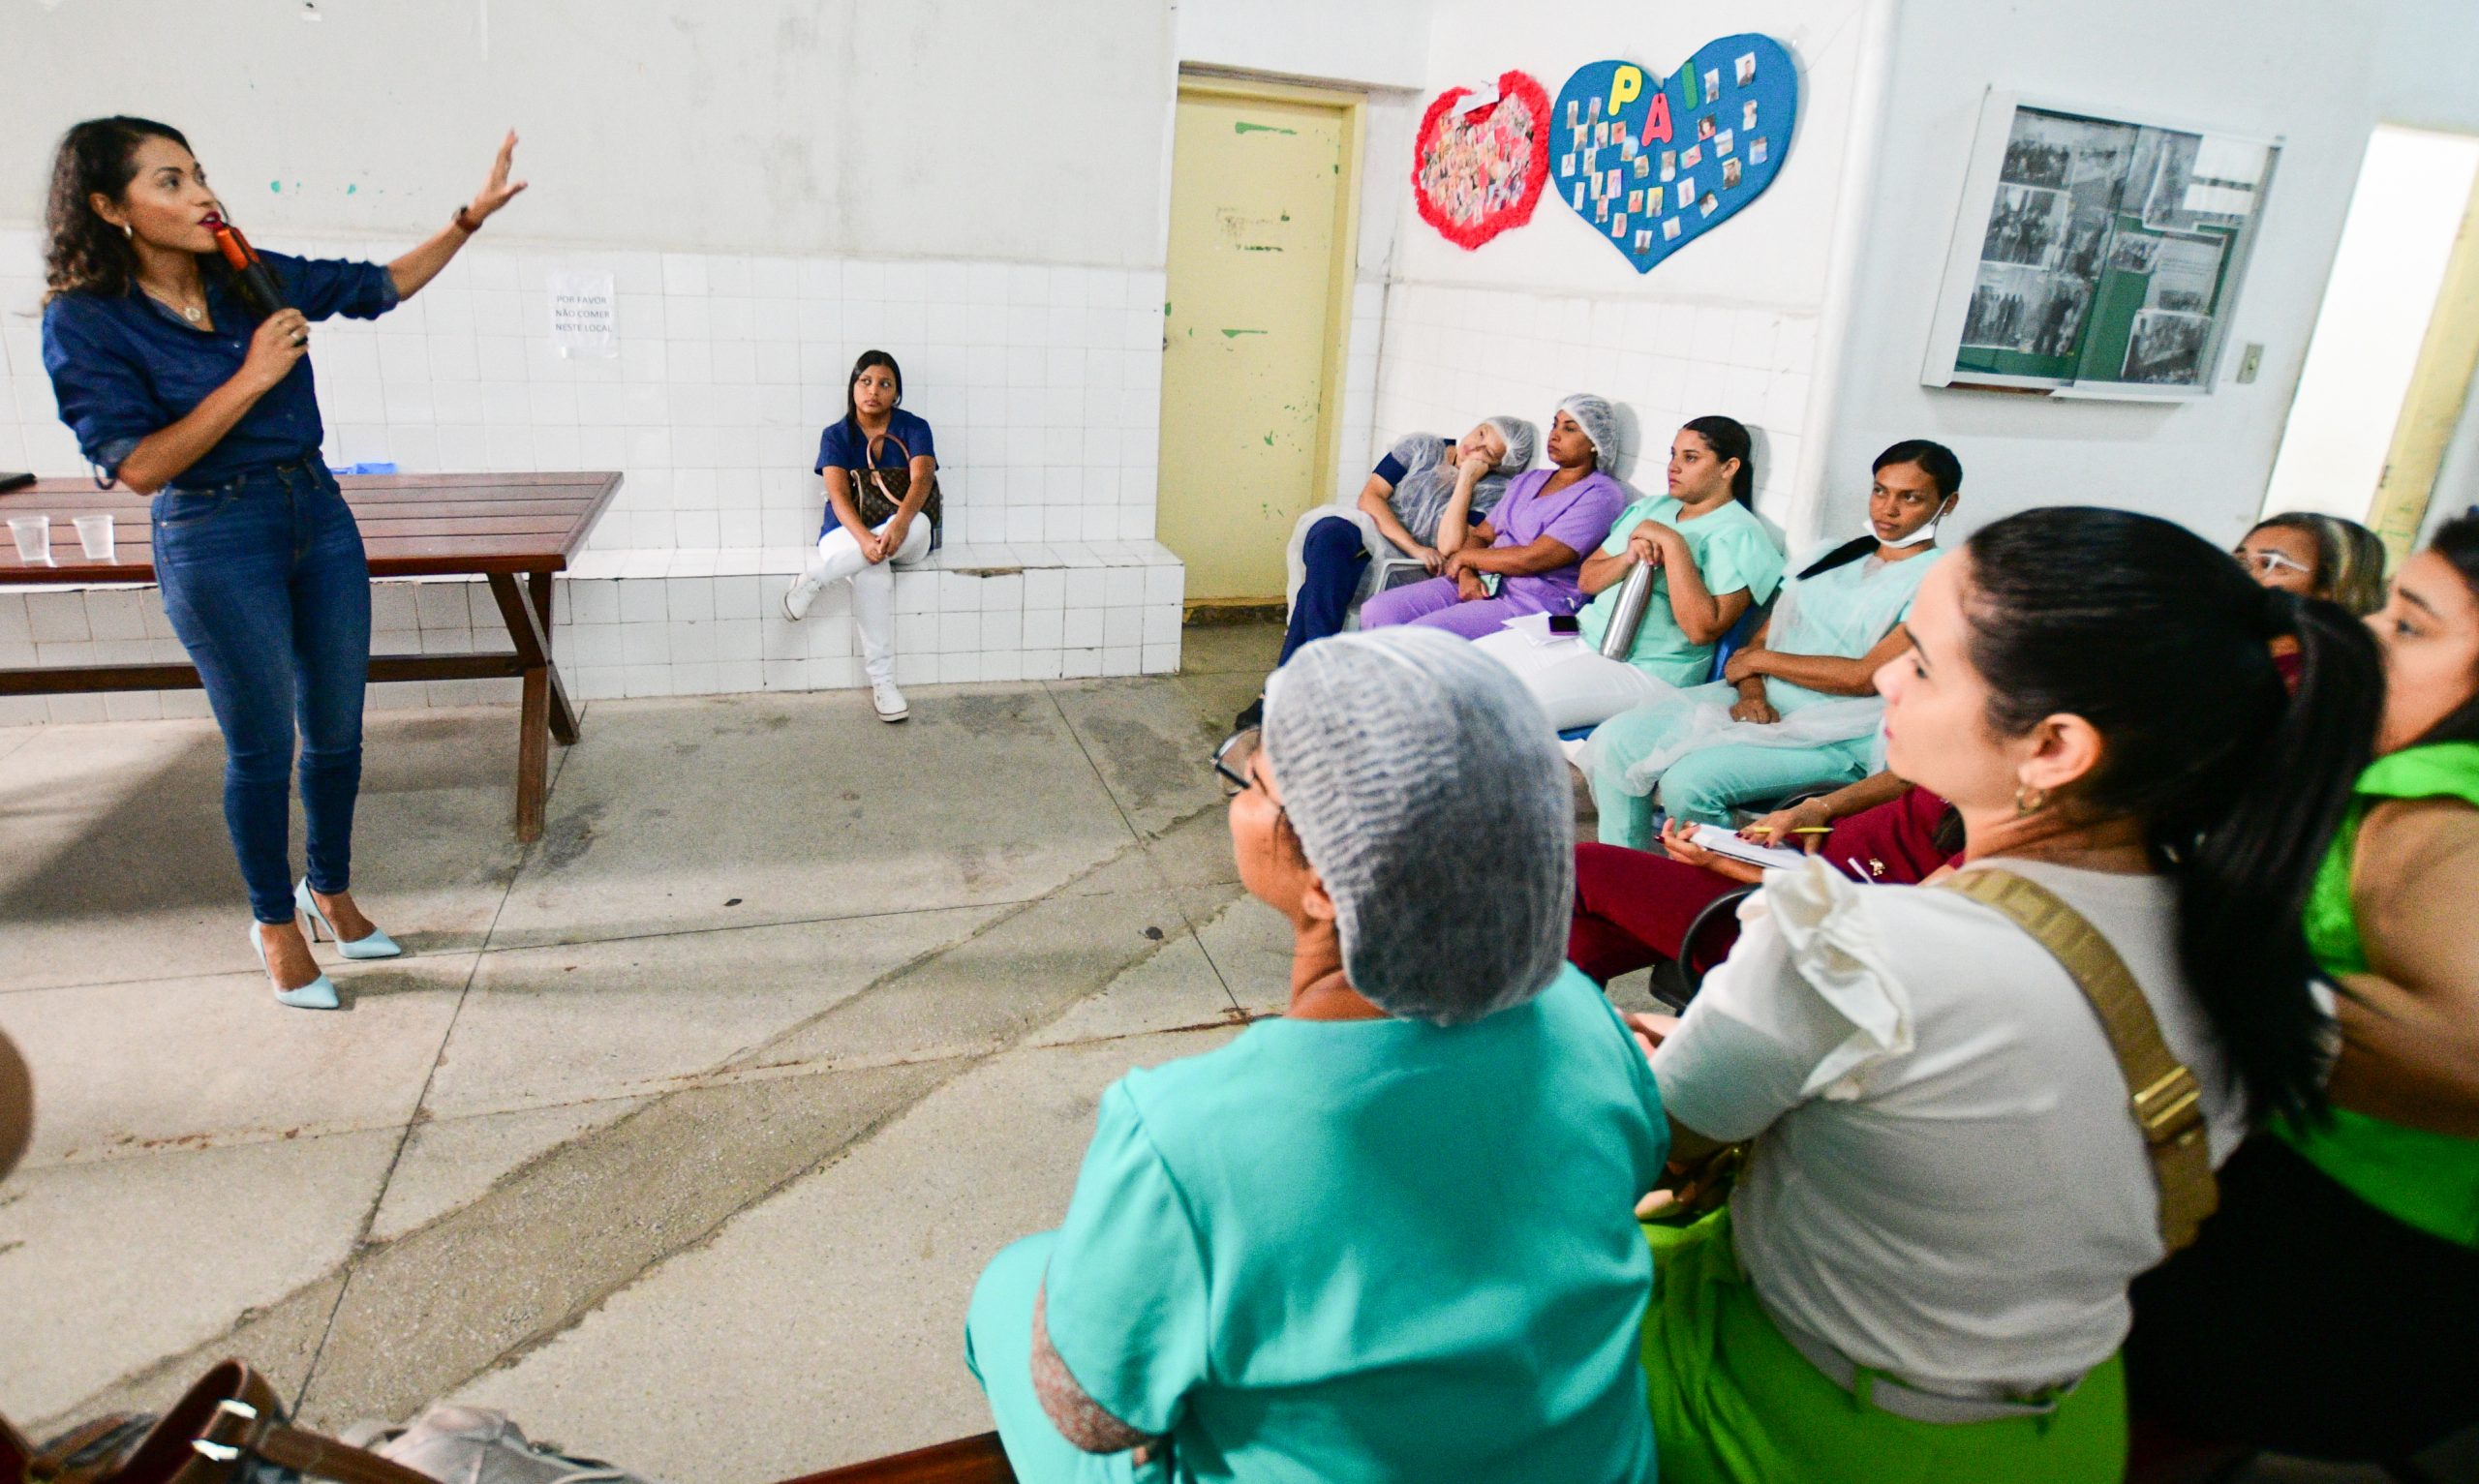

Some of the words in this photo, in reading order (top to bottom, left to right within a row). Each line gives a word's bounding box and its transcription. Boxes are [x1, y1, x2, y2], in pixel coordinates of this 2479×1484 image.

[1608, 61, 1699, 147] PAI
[557, 294, 574, 304] POR
[577, 295, 607, 305] FAVOR
[555, 308, 576, 318] NÃO
[577, 310, 610, 318] COMER
[555, 323, 582, 332] NESTE
[585, 324, 613, 333] LOCAL
